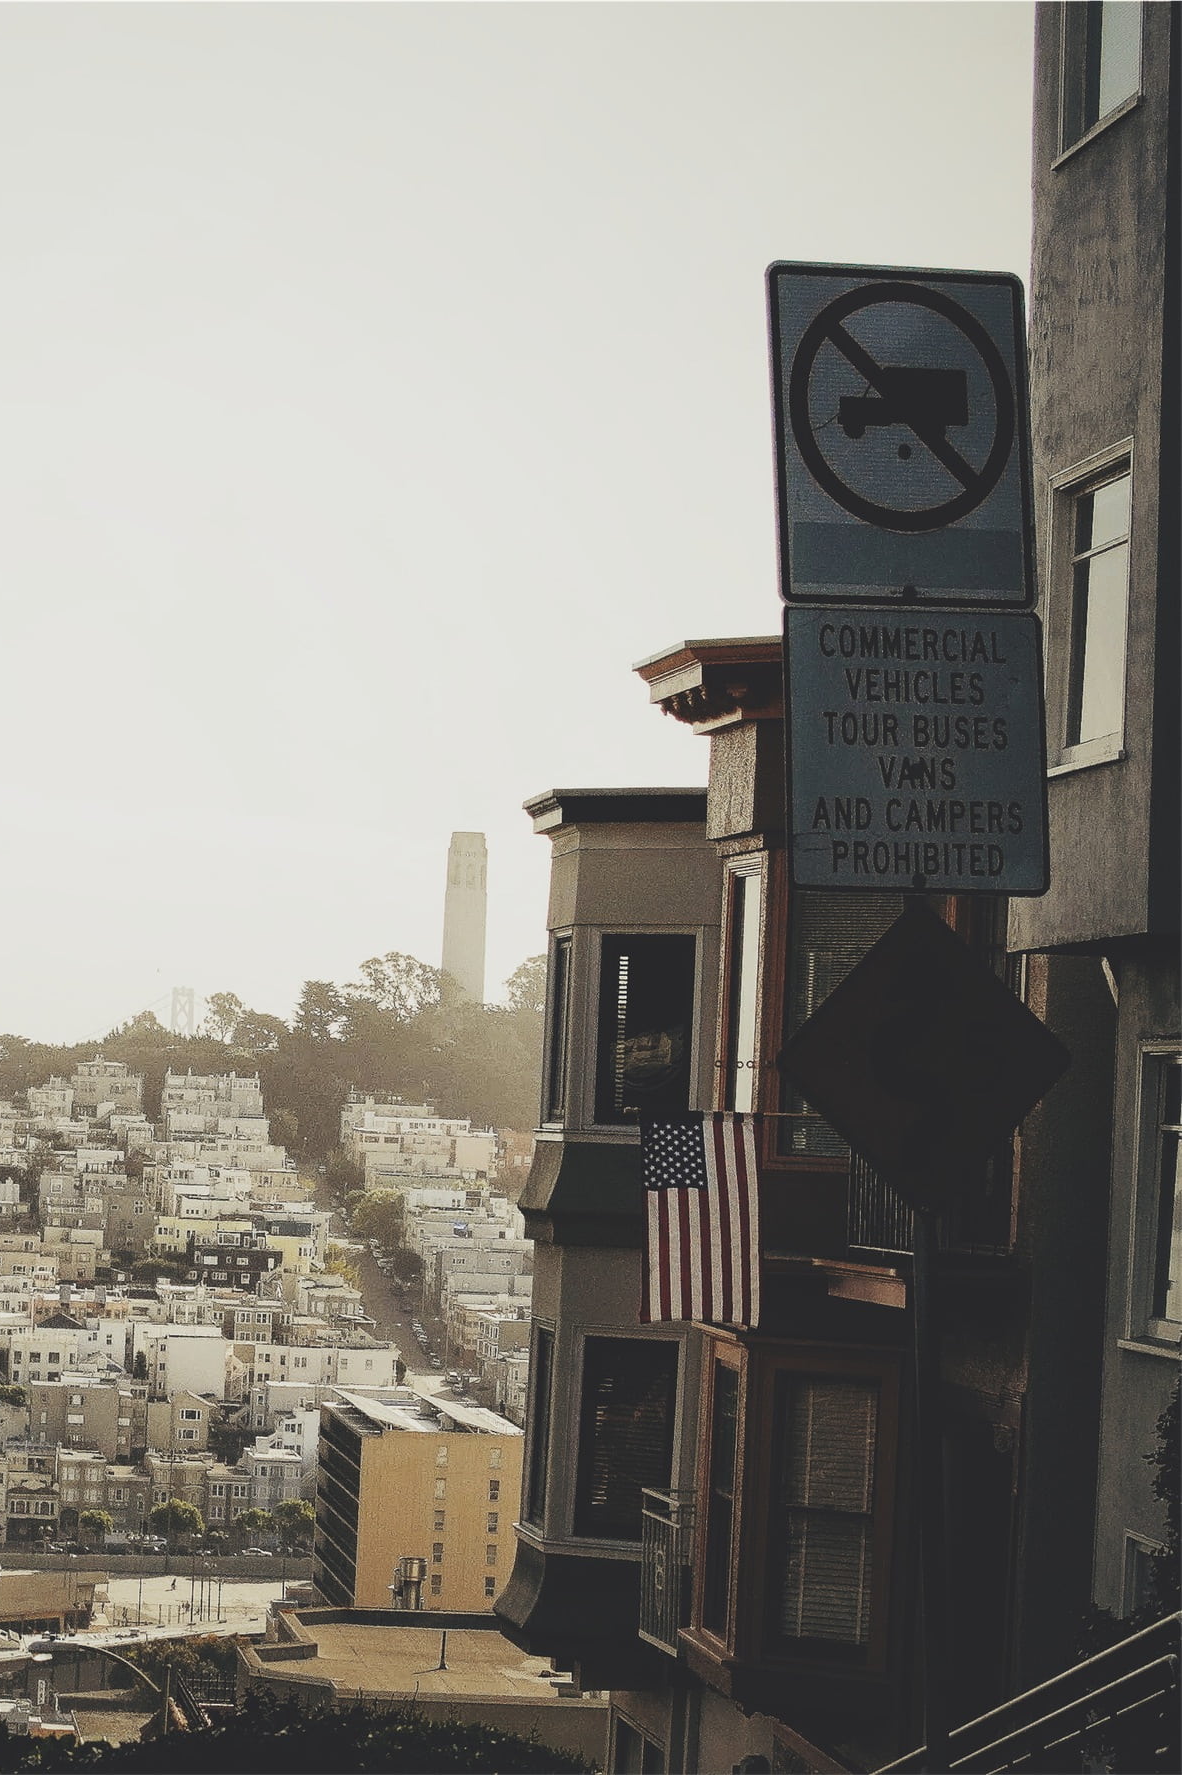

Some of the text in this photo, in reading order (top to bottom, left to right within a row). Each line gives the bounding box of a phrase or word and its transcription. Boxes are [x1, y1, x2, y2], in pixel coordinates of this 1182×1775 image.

[819, 625, 1006, 663] COMMERCIAL
[845, 668, 984, 705] VEHICLES
[823, 711, 1008, 749] TOUR BUSES
[878, 756, 956, 790] VANS
[812, 797, 1023, 834] AND CAMPERS
[832, 841, 1004, 876] PROHIBITED
